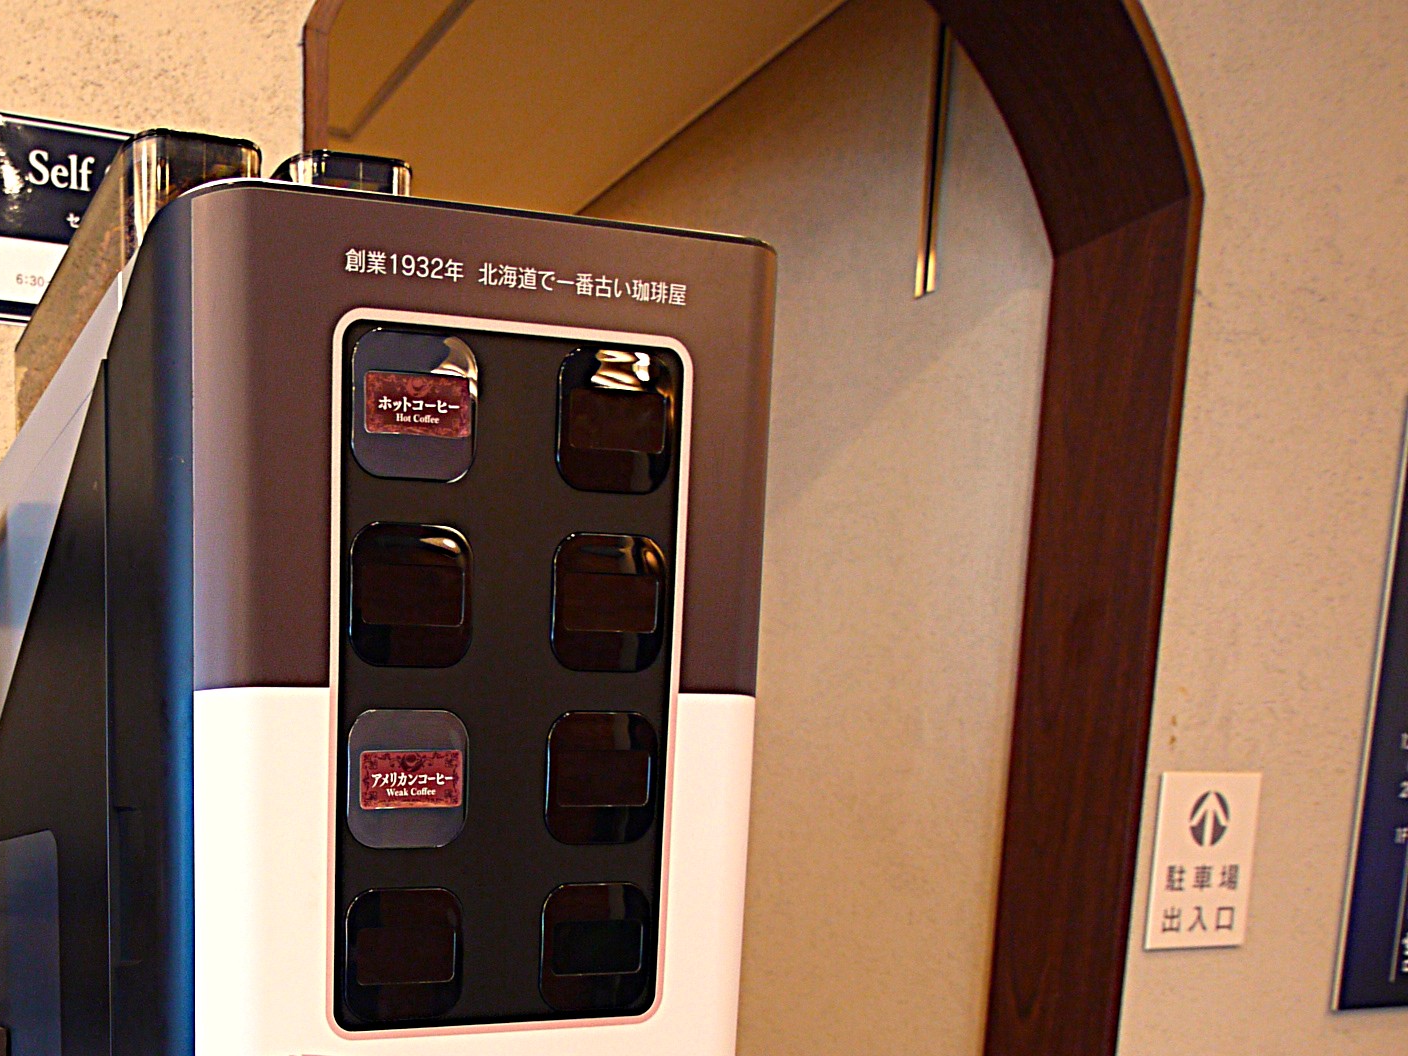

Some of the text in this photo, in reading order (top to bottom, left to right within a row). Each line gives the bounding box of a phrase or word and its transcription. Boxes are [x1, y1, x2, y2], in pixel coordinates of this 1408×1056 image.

[28, 149, 95, 191] Self
[345, 248, 687, 306] 創業1932年 北海道で一番古い珈琲屋
[378, 396, 460, 414] ホットコーヒー
[395, 413, 440, 424] Hot Coffee
[371, 772, 453, 788] アメリカンコーヒー
[386, 787, 436, 797] Weak Coffee
[1165, 864, 1240, 892] 駐車場
[1161, 906, 1235, 933] 出入口
